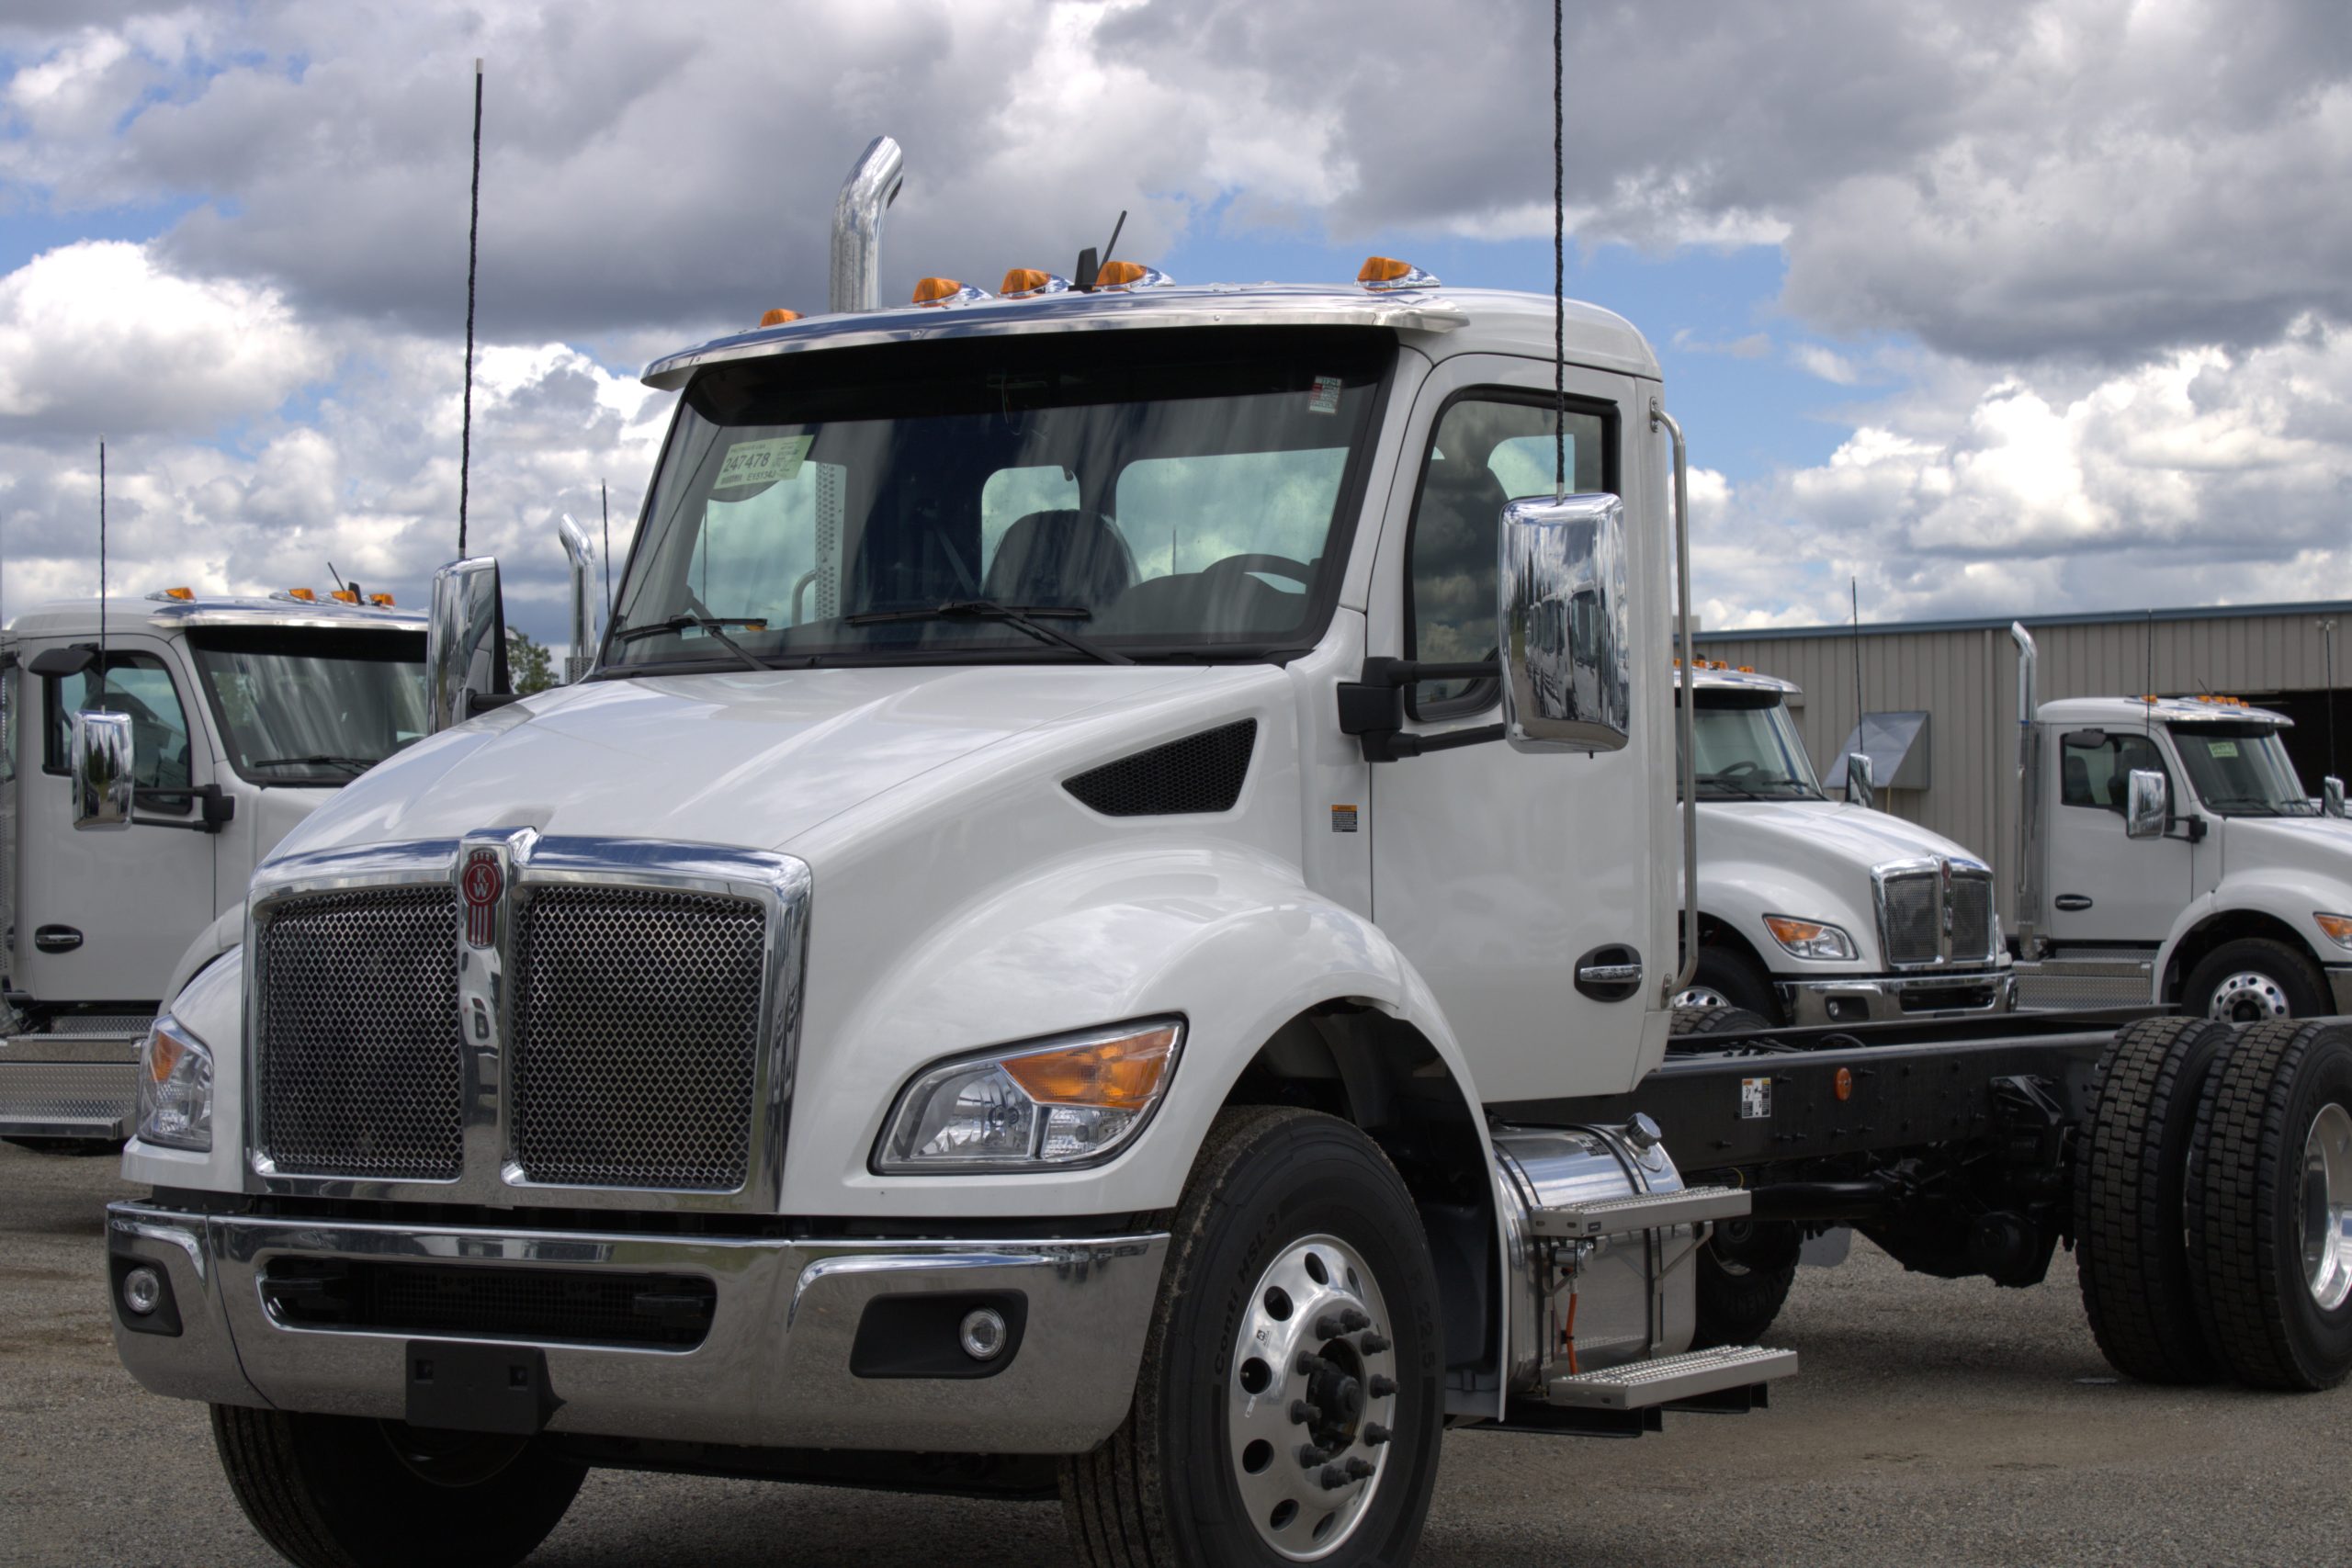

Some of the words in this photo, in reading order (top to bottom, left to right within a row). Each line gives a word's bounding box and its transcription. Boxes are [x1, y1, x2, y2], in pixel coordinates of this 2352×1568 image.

[723, 452, 771, 472] 247478
[476, 868, 486, 882] K
[472, 883, 490, 897] W
[1215, 1288, 1238, 1375] Conti
[1415, 1302, 1436, 1370] 22.5
